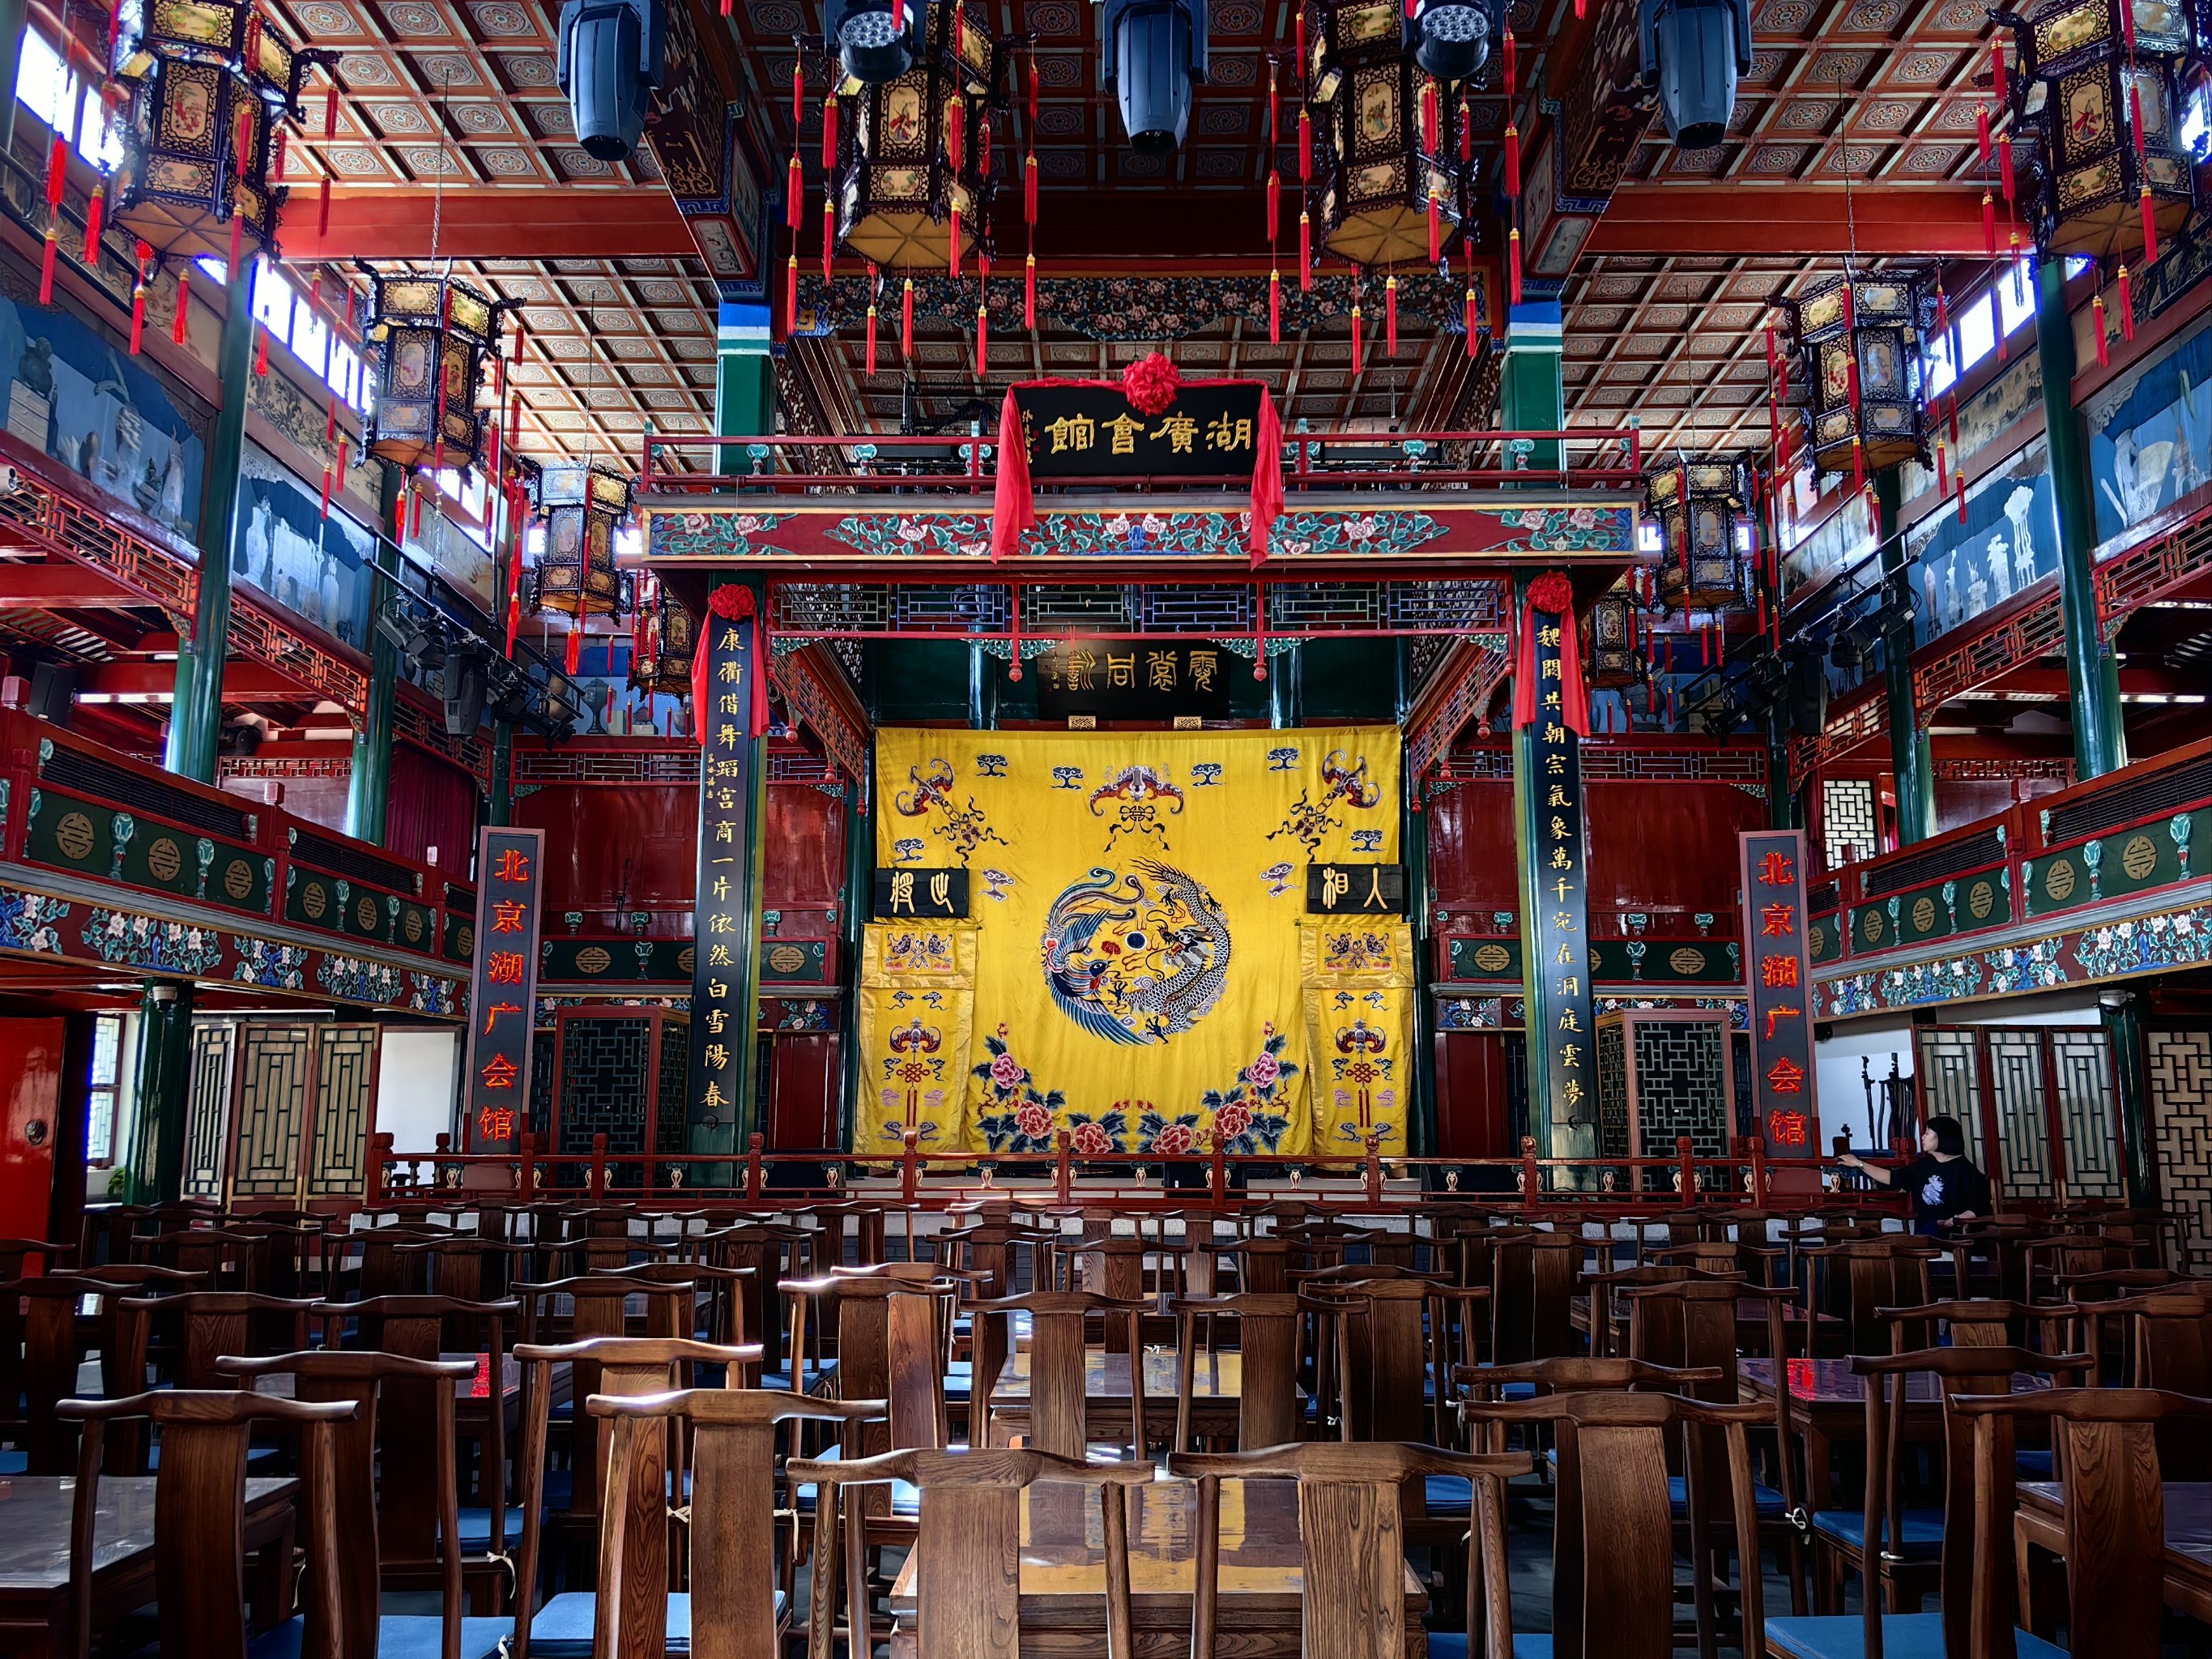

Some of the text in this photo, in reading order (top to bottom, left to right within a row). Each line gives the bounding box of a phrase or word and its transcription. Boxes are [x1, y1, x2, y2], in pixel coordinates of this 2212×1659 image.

[1044, 410, 1251, 454] 湖廣會館
[478, 848, 531, 1142] 北京湖广会馆
[1756, 851, 1808, 1147] 北京湖广会馆
